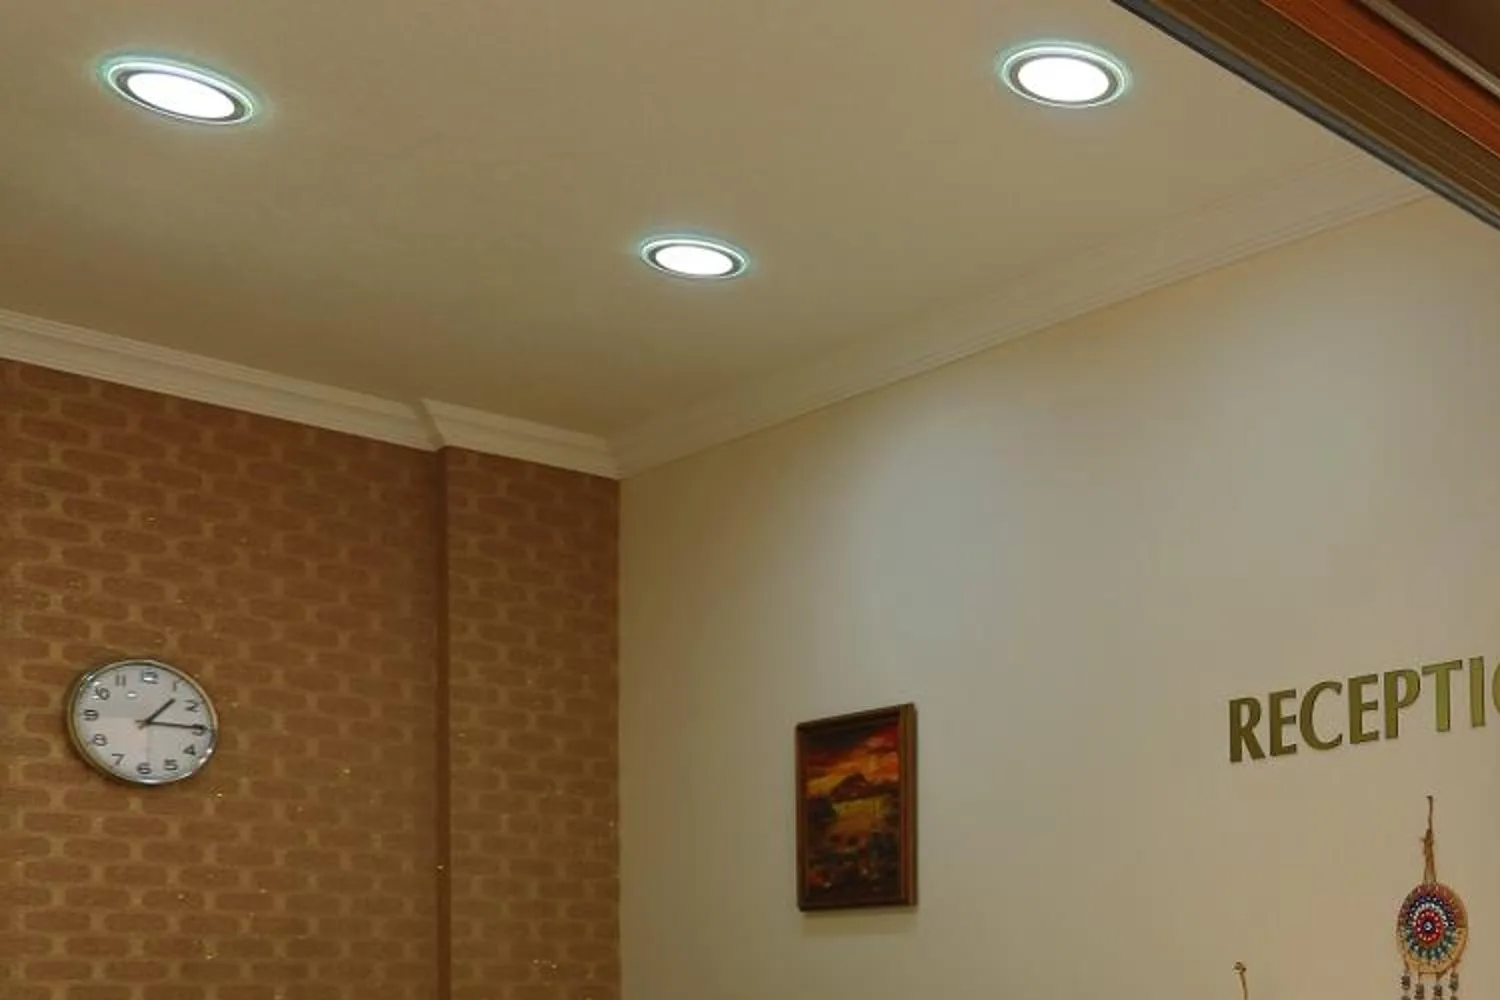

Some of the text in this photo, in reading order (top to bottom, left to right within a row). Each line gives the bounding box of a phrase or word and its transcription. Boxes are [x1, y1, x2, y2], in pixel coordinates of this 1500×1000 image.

[185, 700, 200, 712] 2
[84, 709, 99, 721] 9
[92, 733, 107, 746] 8
[183, 744, 196, 756] 4
[112, 753, 125, 765] 7
[163, 759, 178, 771] 5
[136, 763, 152, 775] 6
